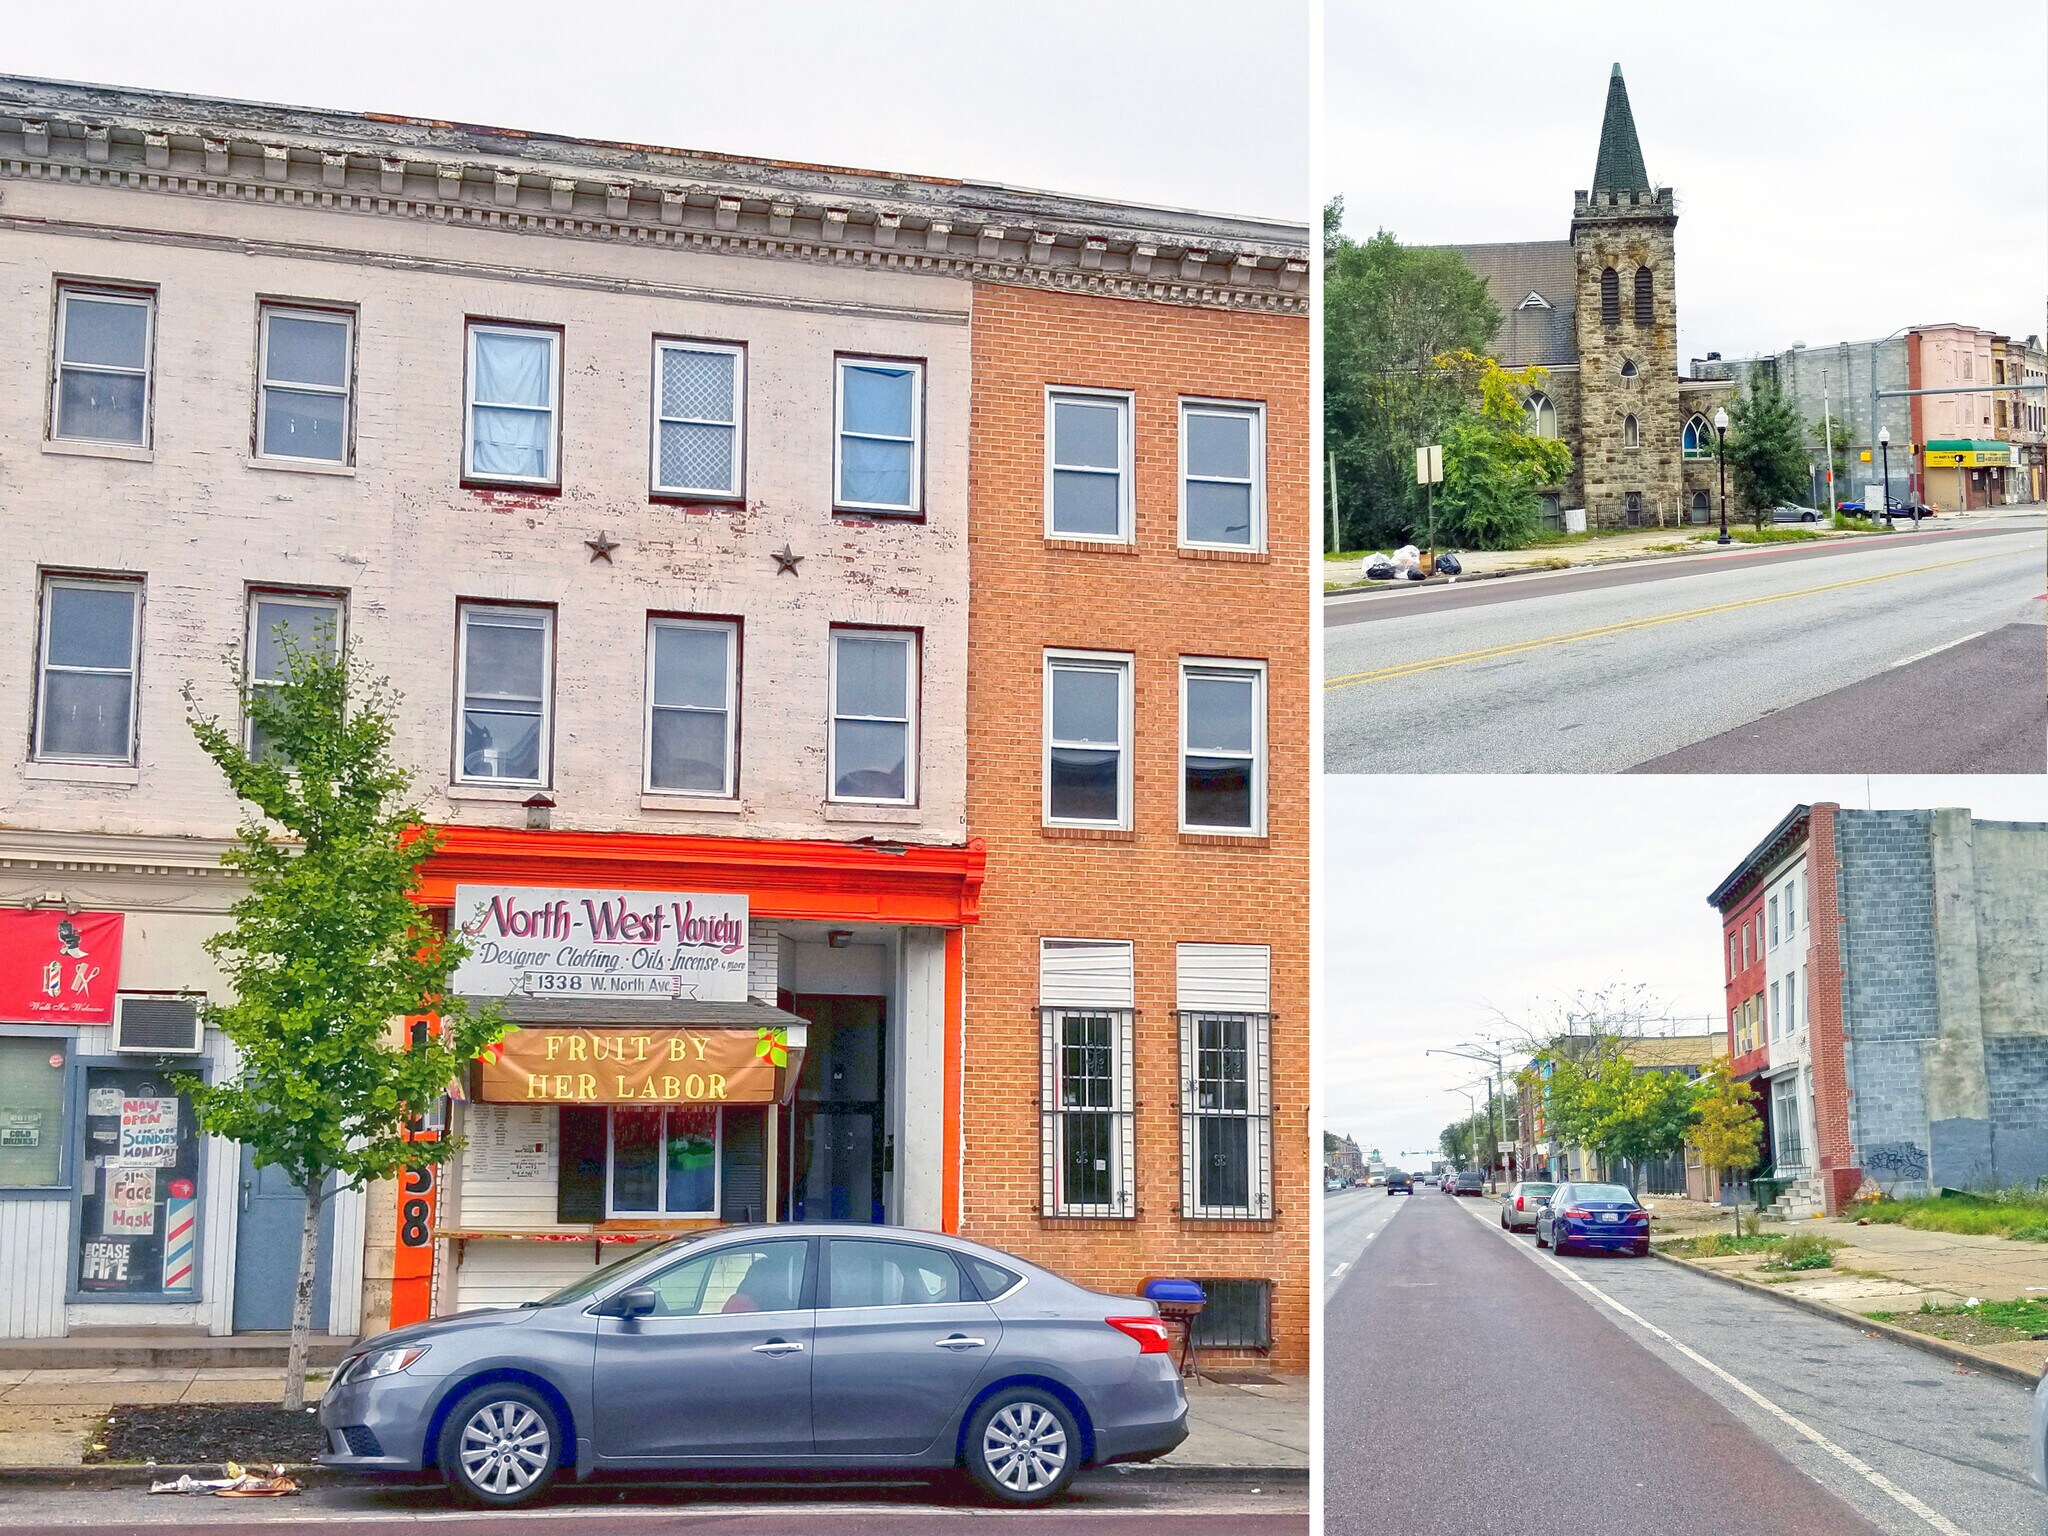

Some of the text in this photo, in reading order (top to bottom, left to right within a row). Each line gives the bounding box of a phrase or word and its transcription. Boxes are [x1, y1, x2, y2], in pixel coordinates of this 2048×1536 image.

[482, 941, 551, 969] Designer
[631, 947, 664, 969] Oils
[669, 949, 719, 971] Incense
[727, 961, 746, 971] more
[537, 974, 582, 989] 1338
[591, 976, 609, 990] W.
[610, 976, 645, 992] North
[29, 1001, 105, 1012] Walk Ins Welcome
[545, 1035, 711, 1062] FRUIT BY
[526, 1073, 728, 1100] HER LABOR
[123, 1100, 160, 1113] NOW
[122, 1113, 162, 1126] OPEN
[2, 1137, 37, 1146] DRINKS!
[10, 1130, 31, 1138] COLD
[122, 1128, 177, 1148] SUNDAY
[123, 1145, 175, 1158] MONDAY
[114, 1181, 152, 1200] Face
[112, 1209, 153, 1228] Mask
[91, 1242, 131, 1259] CEASE
